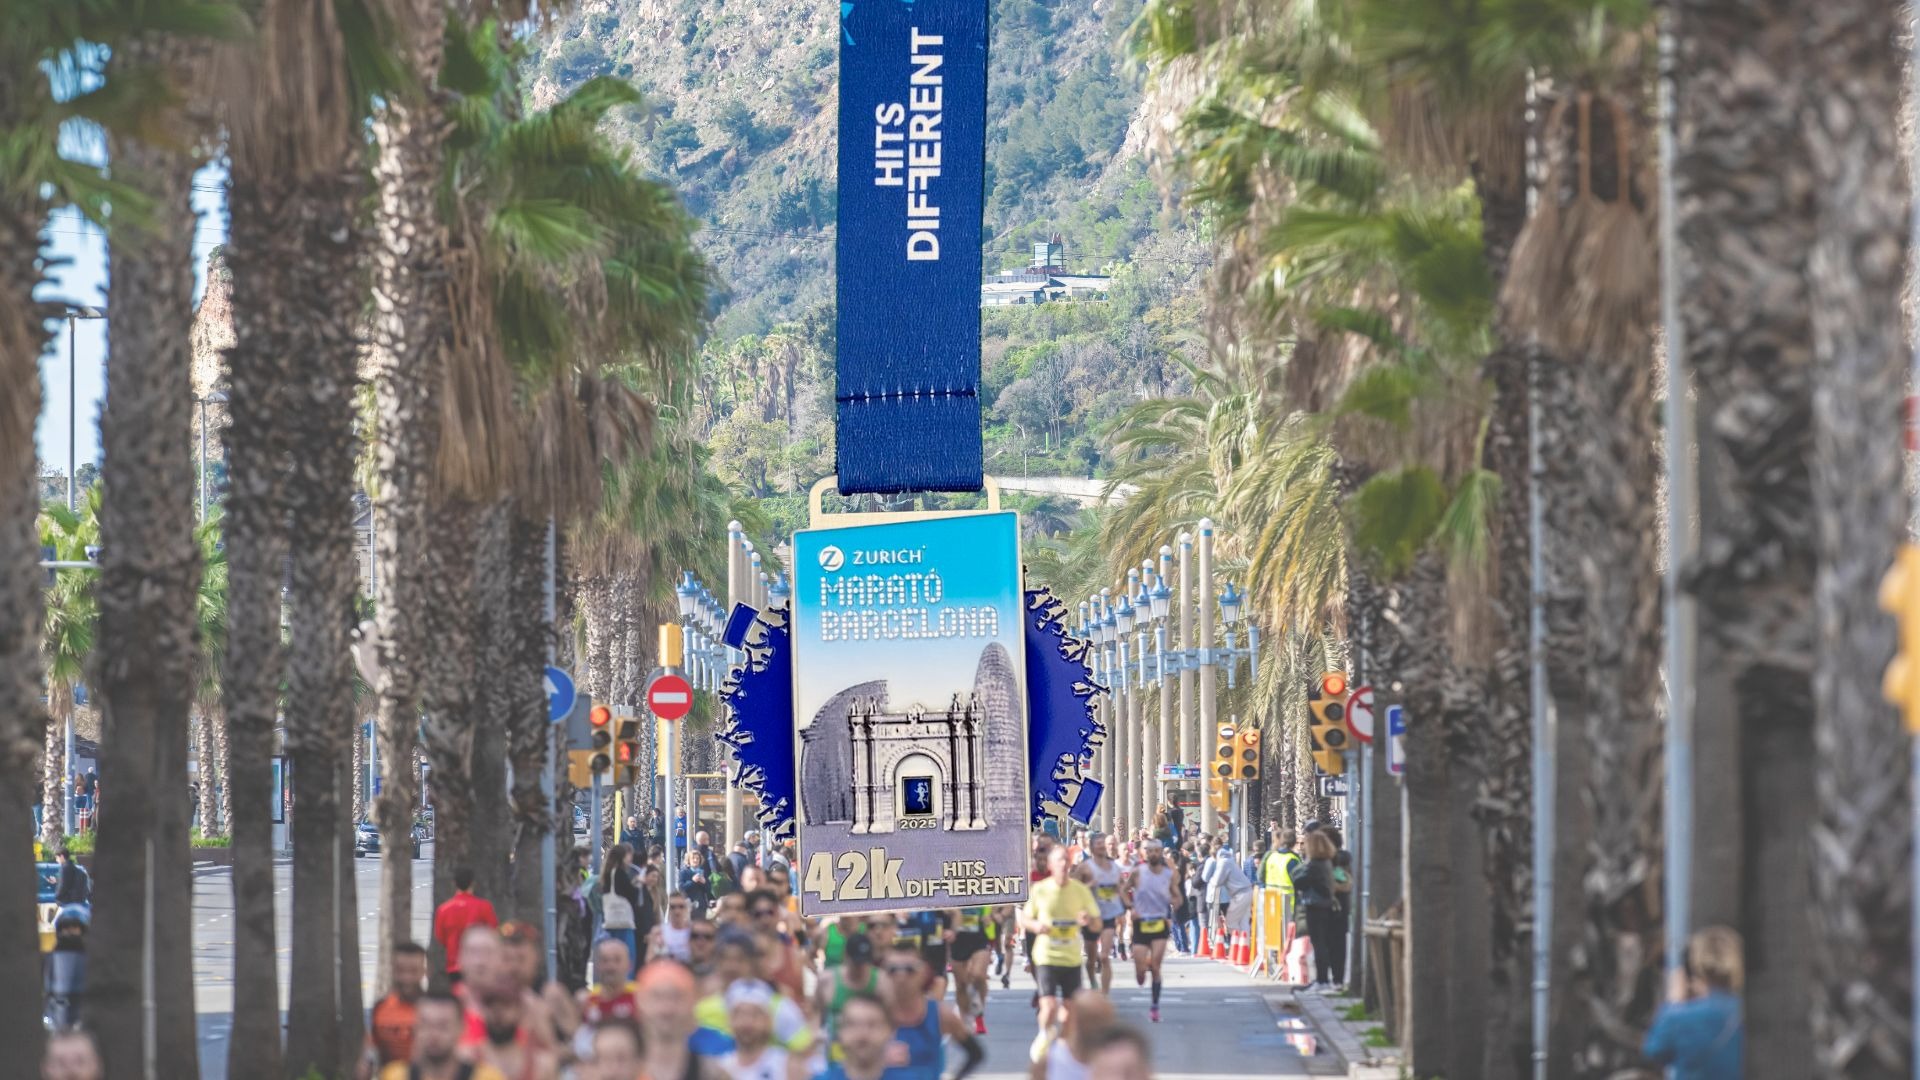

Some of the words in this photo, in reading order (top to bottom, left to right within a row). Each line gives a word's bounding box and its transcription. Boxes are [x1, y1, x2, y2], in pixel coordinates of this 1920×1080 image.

[875, 102, 905, 186] HITS
[907, 26, 943, 261] DIFFERENT
[852, 549, 922, 565] ZURICH
[820, 568, 943, 607] MARATÓ
[820, 606, 999, 641] BARCELONA
[899, 818, 938, 830] 2025
[804, 847, 905, 901] 42k
[906, 876, 1024, 897] DIFFERENT
[943, 860, 987, 878] HITS
